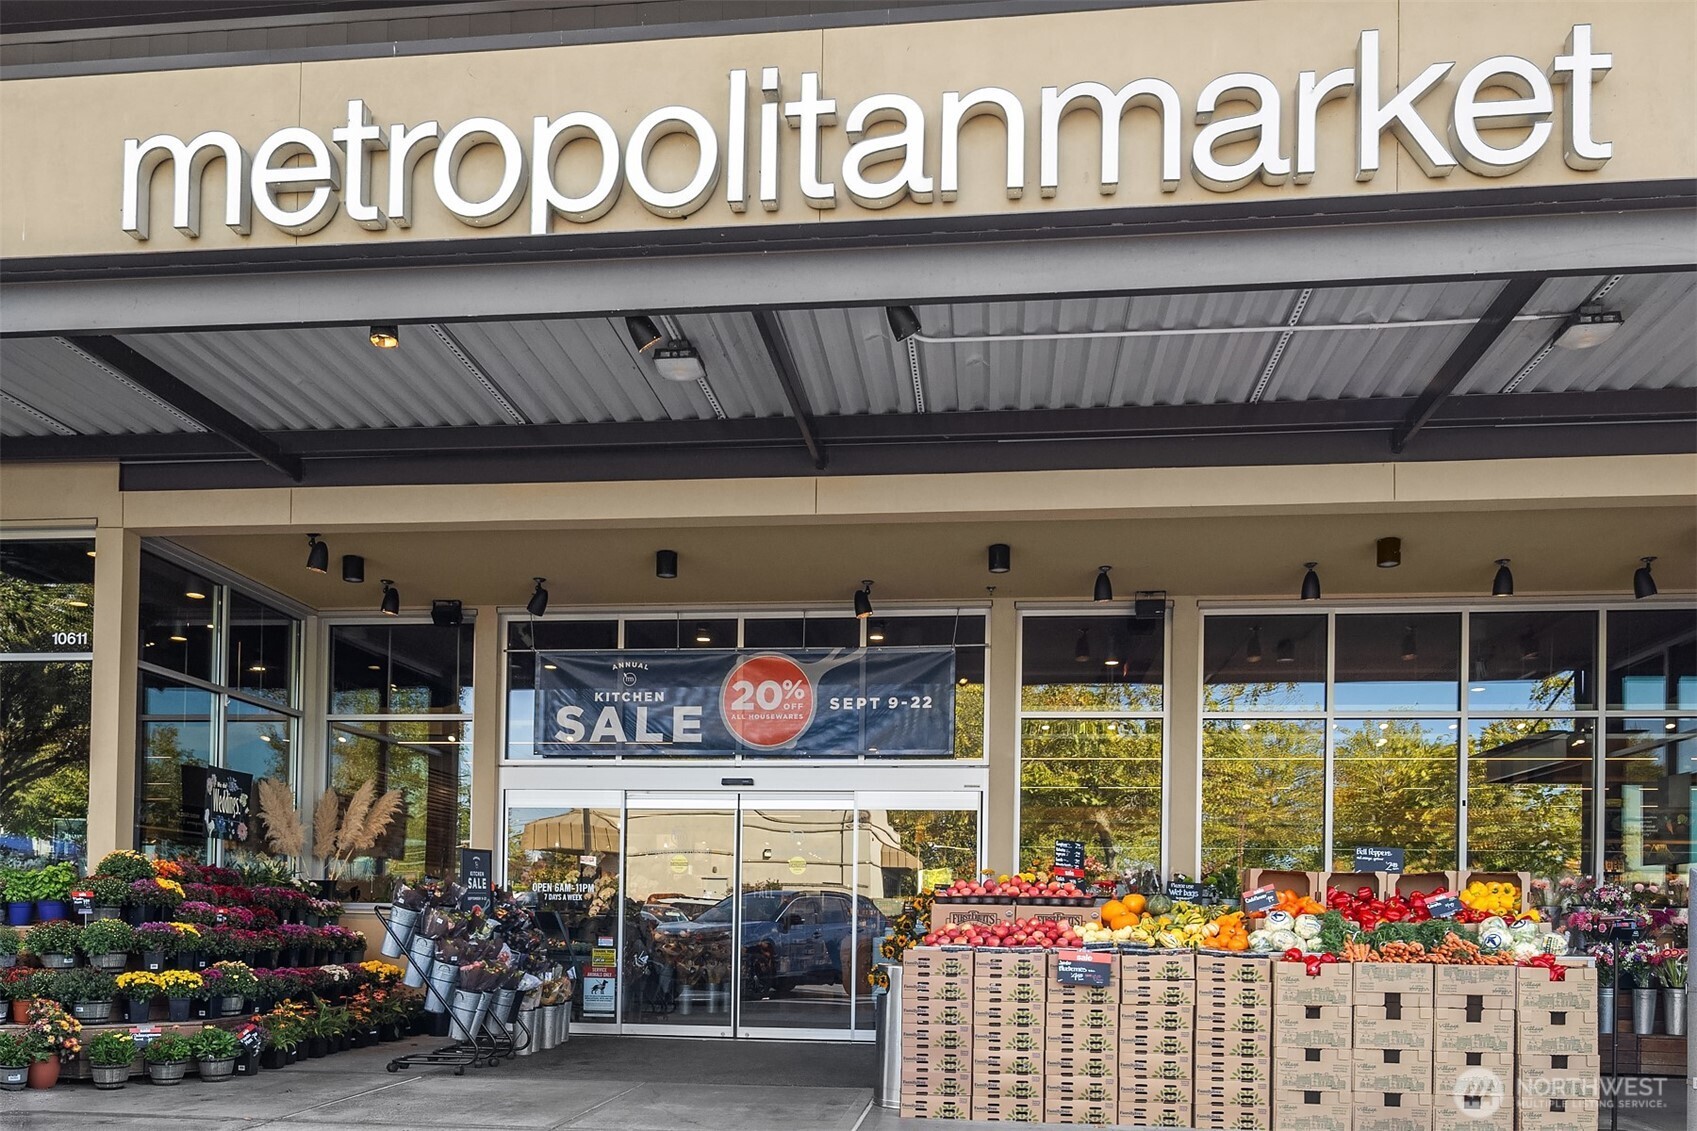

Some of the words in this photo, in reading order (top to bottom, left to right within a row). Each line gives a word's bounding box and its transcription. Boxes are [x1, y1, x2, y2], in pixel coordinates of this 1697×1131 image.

[122, 24, 1613, 240] metropolitanmarket
[52, 632, 87, 645] 10611
[612, 662, 649, 671] ANNUAL
[594, 691, 665, 702] KITCHEN
[731, 679, 804, 711] 20%
[829, 697, 880, 710] SEPT
[888, 696, 933, 709] 9-22
[555, 705, 703, 743] SALE
[468, 877, 487, 889] SALE
[532, 882, 552, 892] OPEN
